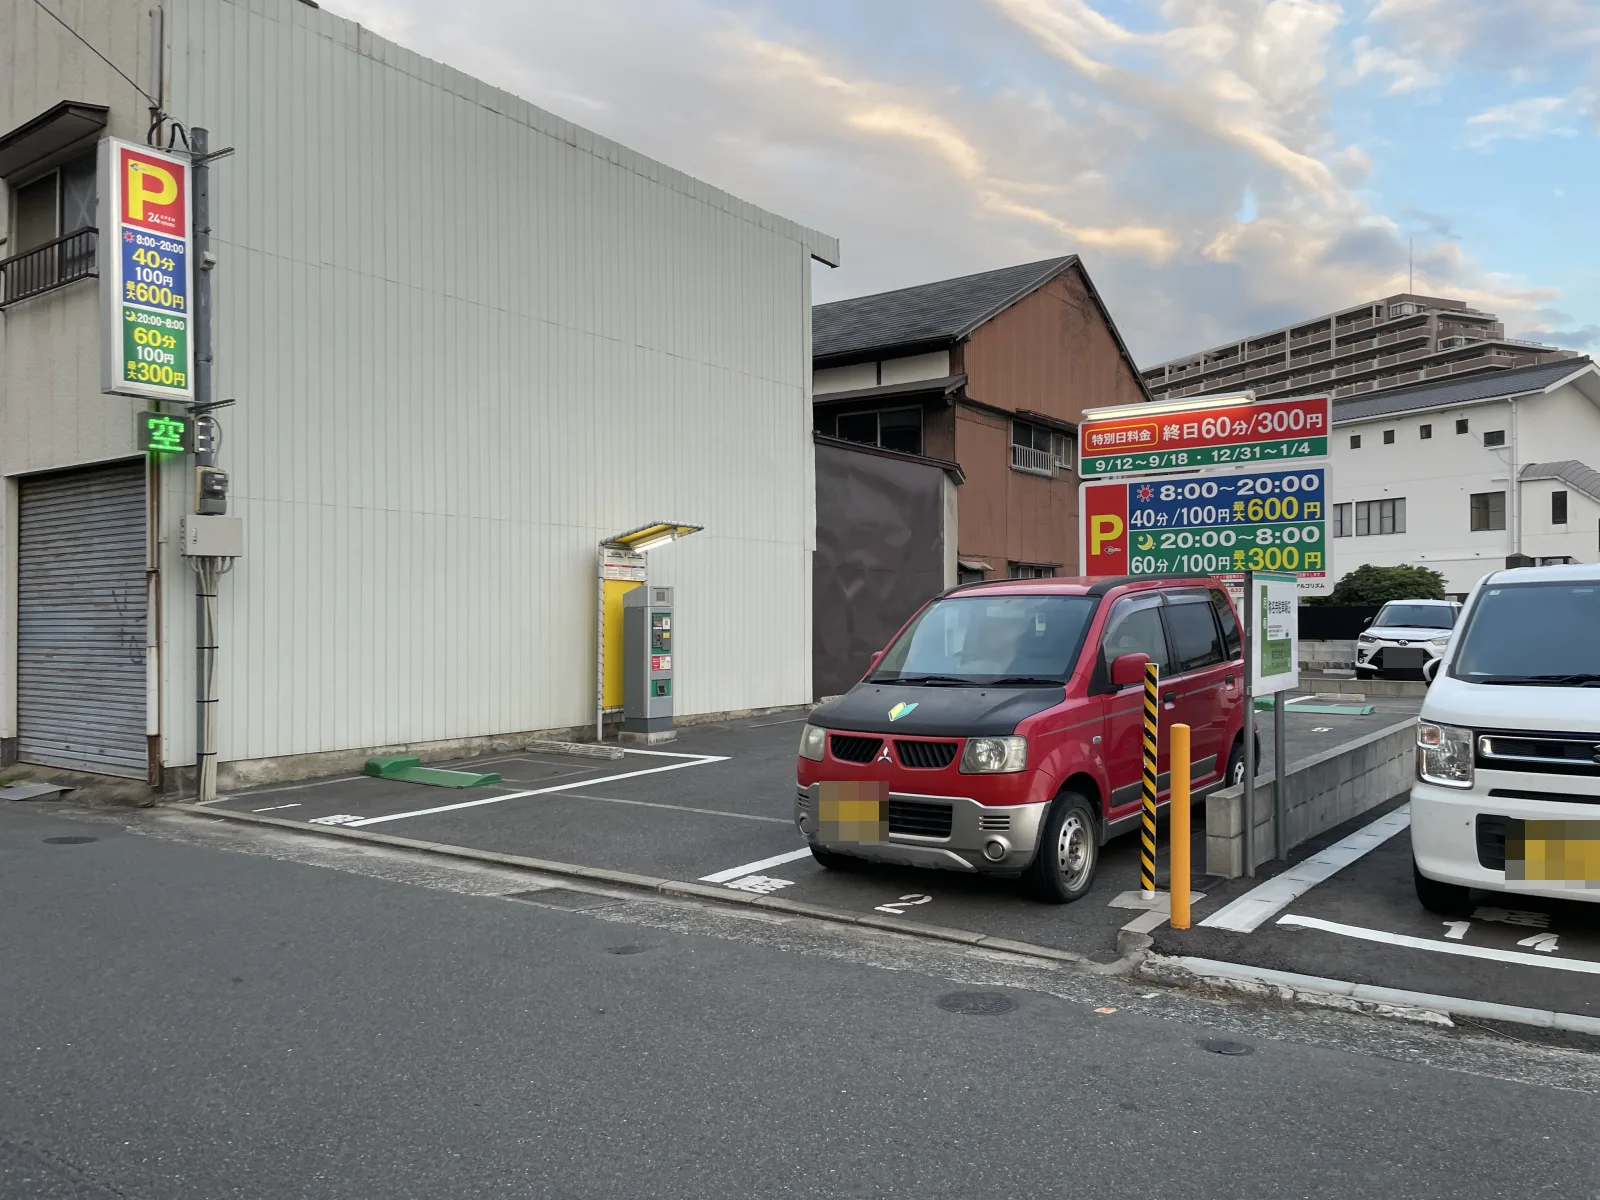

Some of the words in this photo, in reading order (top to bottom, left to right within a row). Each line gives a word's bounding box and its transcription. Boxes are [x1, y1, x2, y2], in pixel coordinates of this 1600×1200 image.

[128, 158, 178, 220] P
[148, 212, 160, 224] 24
[136, 234, 184, 254] 8:00～20:00
[132, 248, 175, 271] 40分
[135, 267, 173, 287] 100円
[137, 312, 184, 330] 20:00～8:00
[134, 327, 176, 349] 60分
[137, 346, 174, 365] 100円
[148, 416, 185, 452] 空
[1091, 429, 1152, 446] 特別日料金
[1159, 474, 1320, 501] 8:00～20:00
[1090, 514, 1124, 556] P
[1160, 526, 1320, 549] 20:00～8:00
[874, 893, 933, 914] 2
